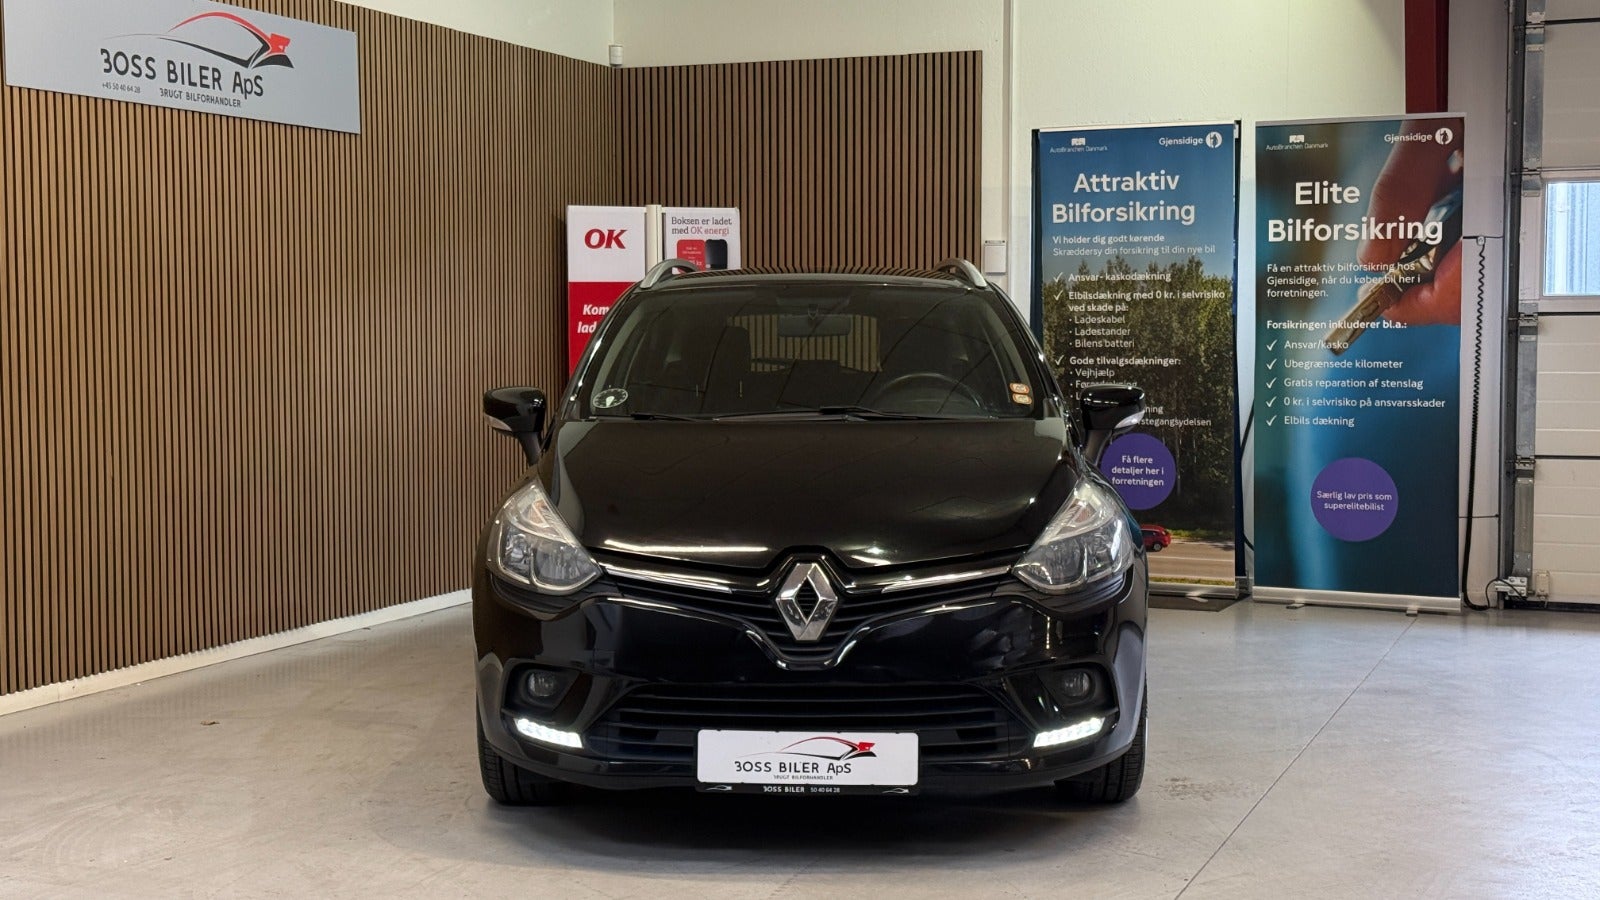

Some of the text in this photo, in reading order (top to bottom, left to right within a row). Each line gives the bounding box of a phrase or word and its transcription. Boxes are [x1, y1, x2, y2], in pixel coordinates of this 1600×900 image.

[167, 59, 222, 92] BILER
[232, 71, 264, 100] ApS
[186, 91, 242, 108] BILFORHANDLER
[1158, 137, 1203, 147] Gjensidige
[1384, 134, 1432, 144] Gjensidige
[1074, 170, 1180, 193] Attraktiv
[1295, 181, 1360, 205] Elite
[1052, 200, 1195, 226] Bilforsikring
[672, 217, 700, 225] Boksen
[712, 217, 732, 225] ladet
[672, 226, 730, 236] med OK energi
[1268, 216, 1442, 245] Bilforsikring
[584, 228, 628, 250] OK
[1053, 234, 1164, 245] Vi holder dig godt kørende
[1053, 245, 1215, 257] Skræddersy din forsikring til din nye bil
[1267, 263, 1278, 273] Få
[1294, 264, 1334, 272] attraktiv
[1337, 263, 1395, 273] bilforsikring
[1068, 272, 1172, 282] Ansvar- kaskodækning
[1267, 275, 1420, 286] Gjensidige, når du køber bil her i
[1068, 292, 1131, 301] Elbilsdækning
[1133, 291, 1154, 299] med
[1163, 291, 1176, 299] kr.
[1182, 291, 1225, 299] selvrisiko
[1267, 288, 1328, 298] forretningen.
[1069, 303, 1129, 313] ved skade på:
[1074, 316, 1125, 324] Ladeskabel
[1266, 320, 1407, 330] Forsikringen inkluderer bl.a.:
[1074, 327, 1130, 336] Ladestander
[1075, 339, 1134, 348] Bilens batteri
[1284, 340, 1349, 350] Ansvar/kasko
[1070, 356, 1181, 367] Gode tilvalgsdækninger:
[1284, 360, 1403, 369] Ubegrænsede kilometer
[1075, 368, 1115, 378] Vejhjælp
[1284, 378, 1423, 390] Gratis reparation af stenslag
[1284, 397, 1445, 408] 0 kr. i selvrisiko på ansvarsskader
[1284, 416, 1354, 427] Elbils dækning
[1112, 467, 1143, 475] detaljer
[1112, 477, 1164, 487] forretningen
[1316, 491, 1342, 500] Særlig
[1358, 492, 1373, 501] pris
[1324, 502, 1384, 511] superelitebilist
[779, 762, 819, 773] BILER
[827, 763, 852, 776] ApS
